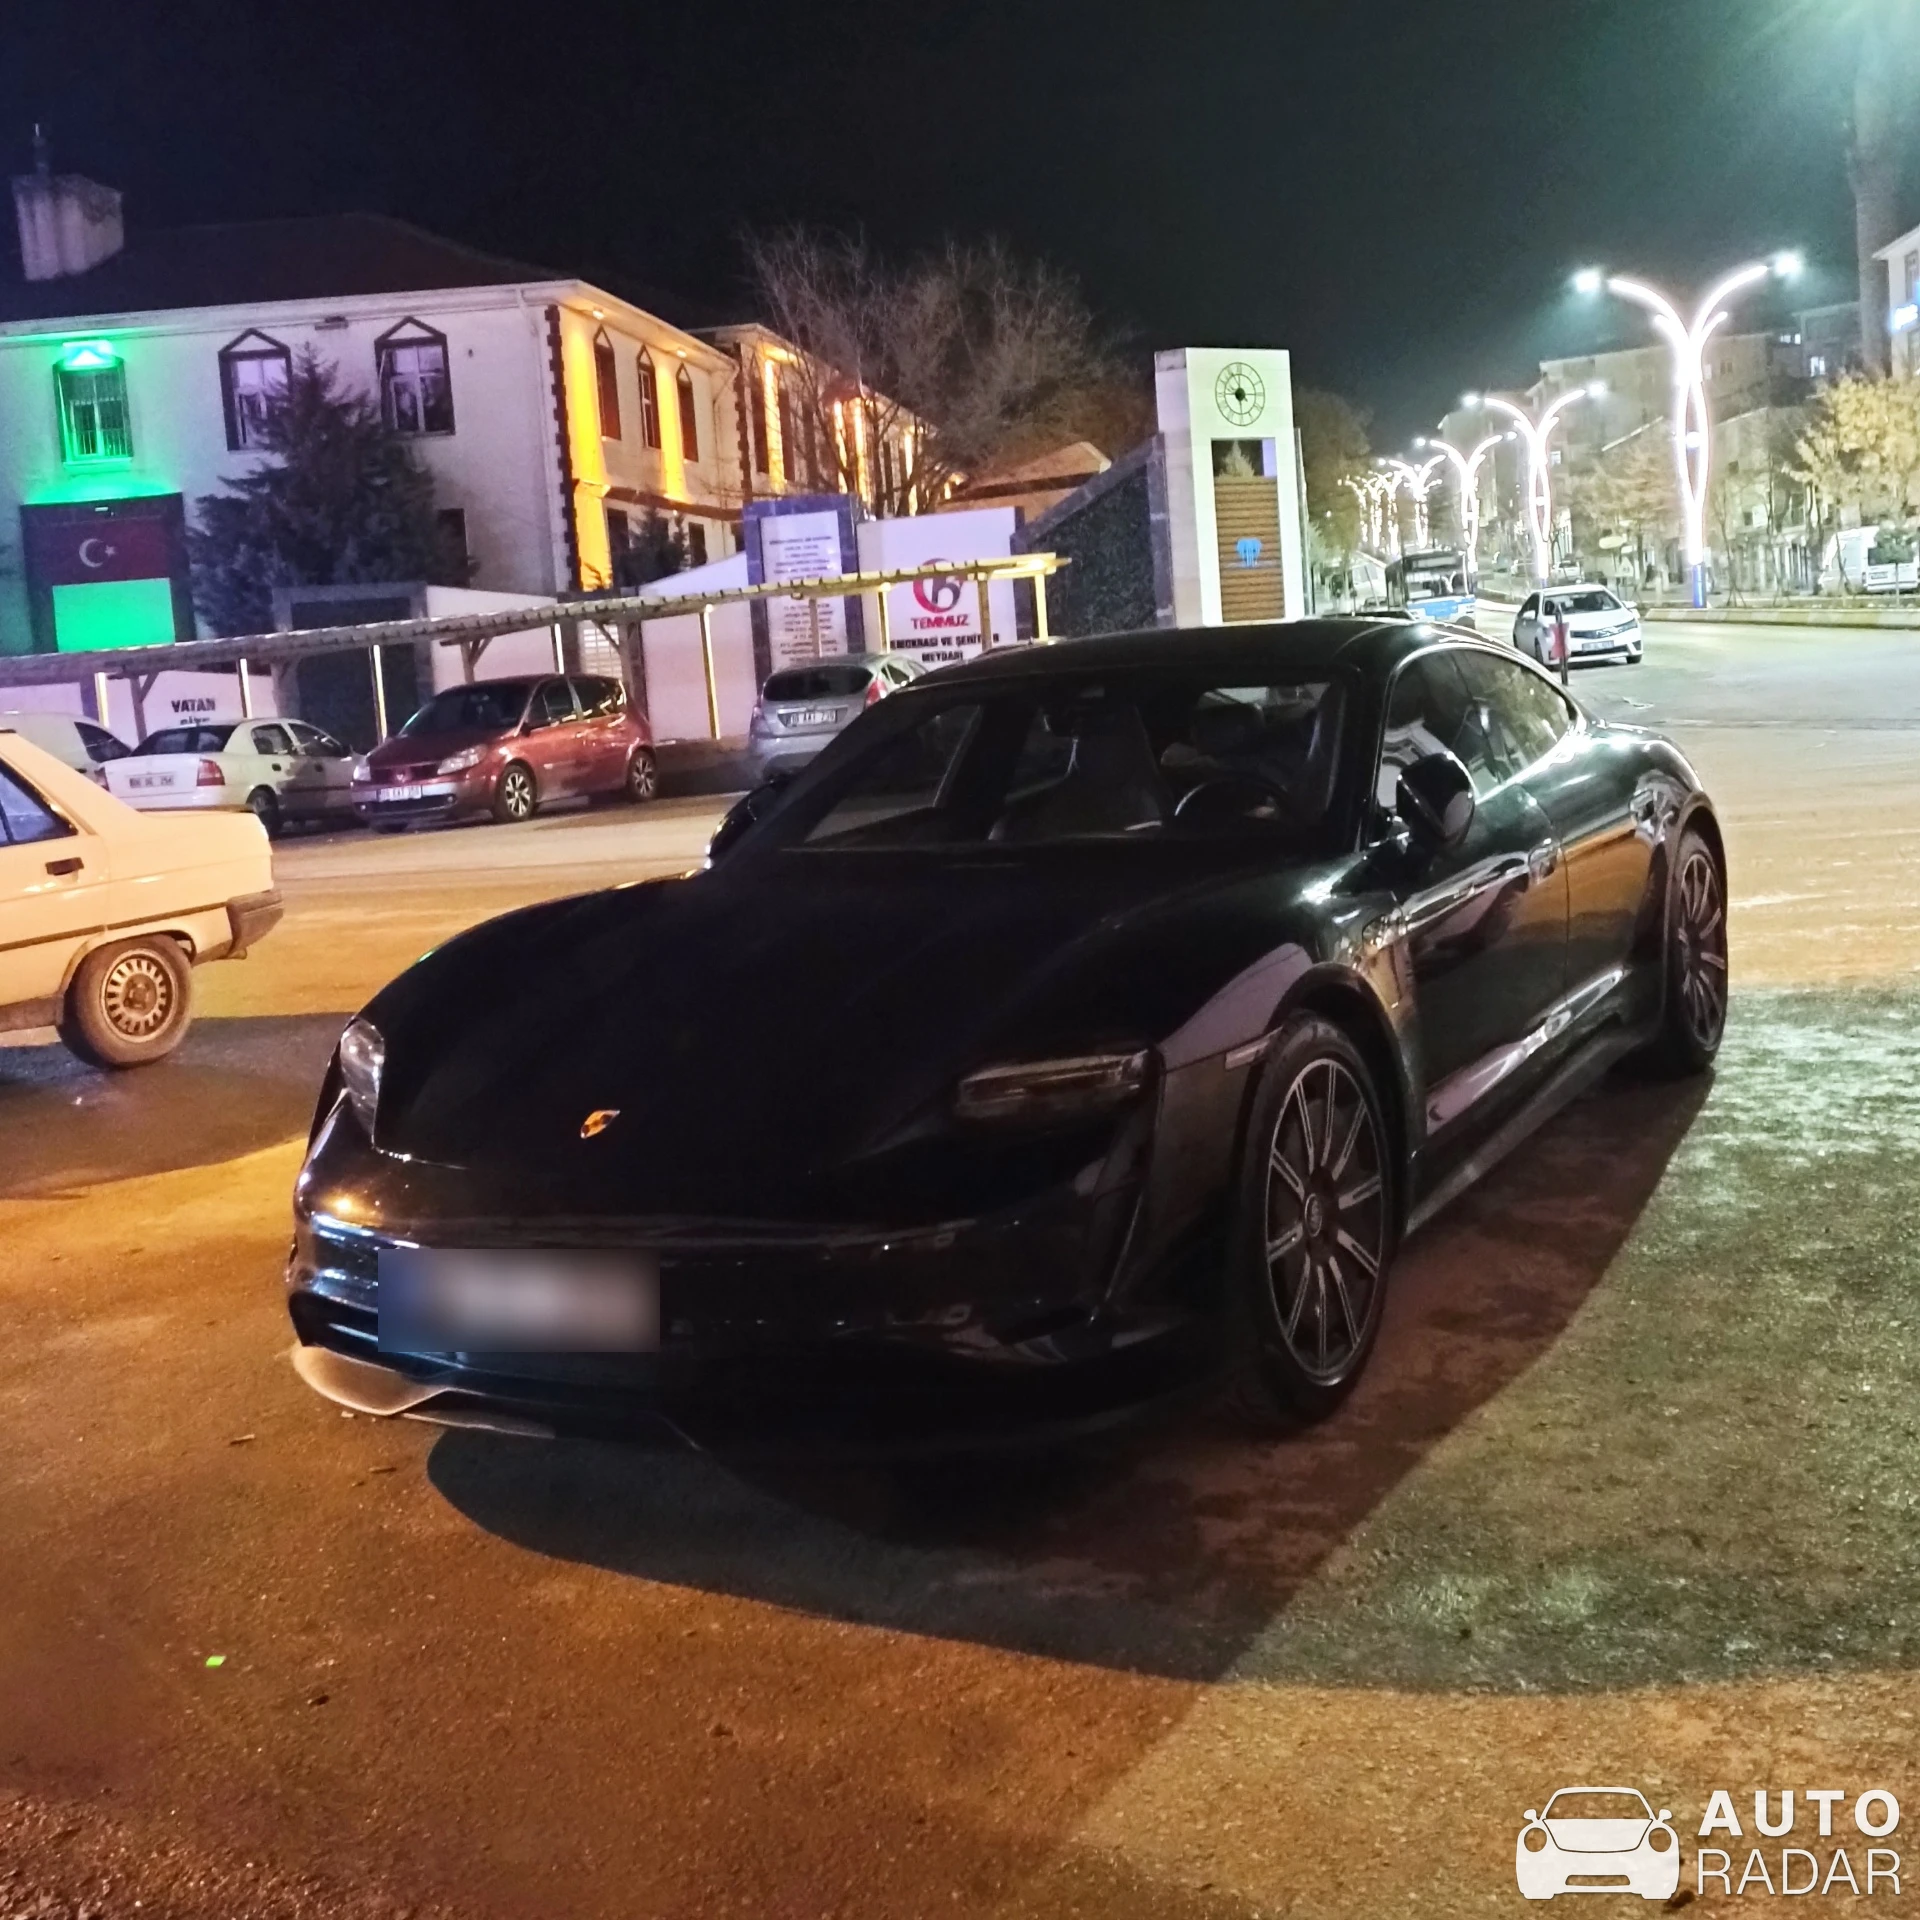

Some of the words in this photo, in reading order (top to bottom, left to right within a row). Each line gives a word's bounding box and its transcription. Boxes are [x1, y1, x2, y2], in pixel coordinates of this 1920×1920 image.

[911, 614, 969, 629] TEMMUZ
[941, 636, 953, 646] VE
[171, 698, 216, 713] VATAN
